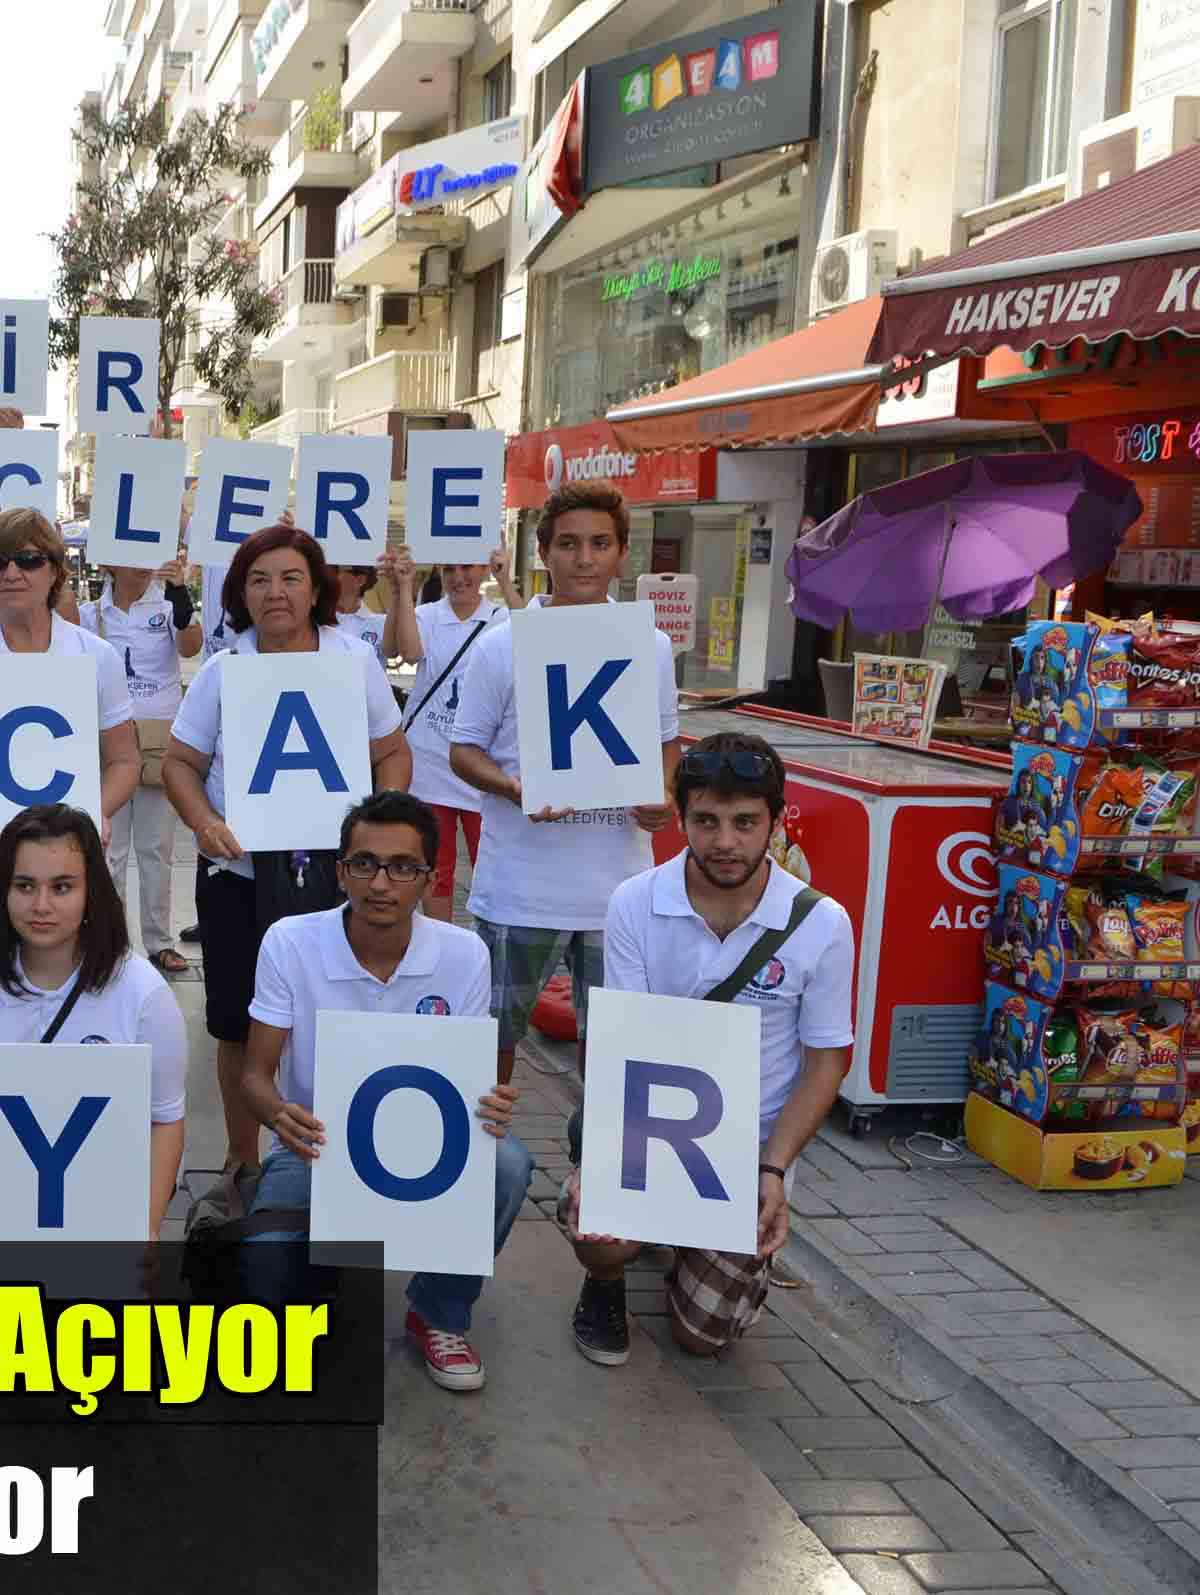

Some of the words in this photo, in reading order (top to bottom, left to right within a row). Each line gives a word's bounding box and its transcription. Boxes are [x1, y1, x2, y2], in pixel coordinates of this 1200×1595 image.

[944, 276, 1121, 336] HAKSEVER
[96, 351, 145, 413] R
[565, 443, 638, 481] vodafone
[114, 473, 161, 543] L
[214, 474, 271, 544] E
[314, 471, 371, 540] R
[431, 467, 484, 538] E
[247, 691, 350, 794] A
[545, 658, 641, 771] K
[929, 905, 991, 929] ALG
[346, 1064, 471, 1202] O
[621, 1059, 732, 1202] R
